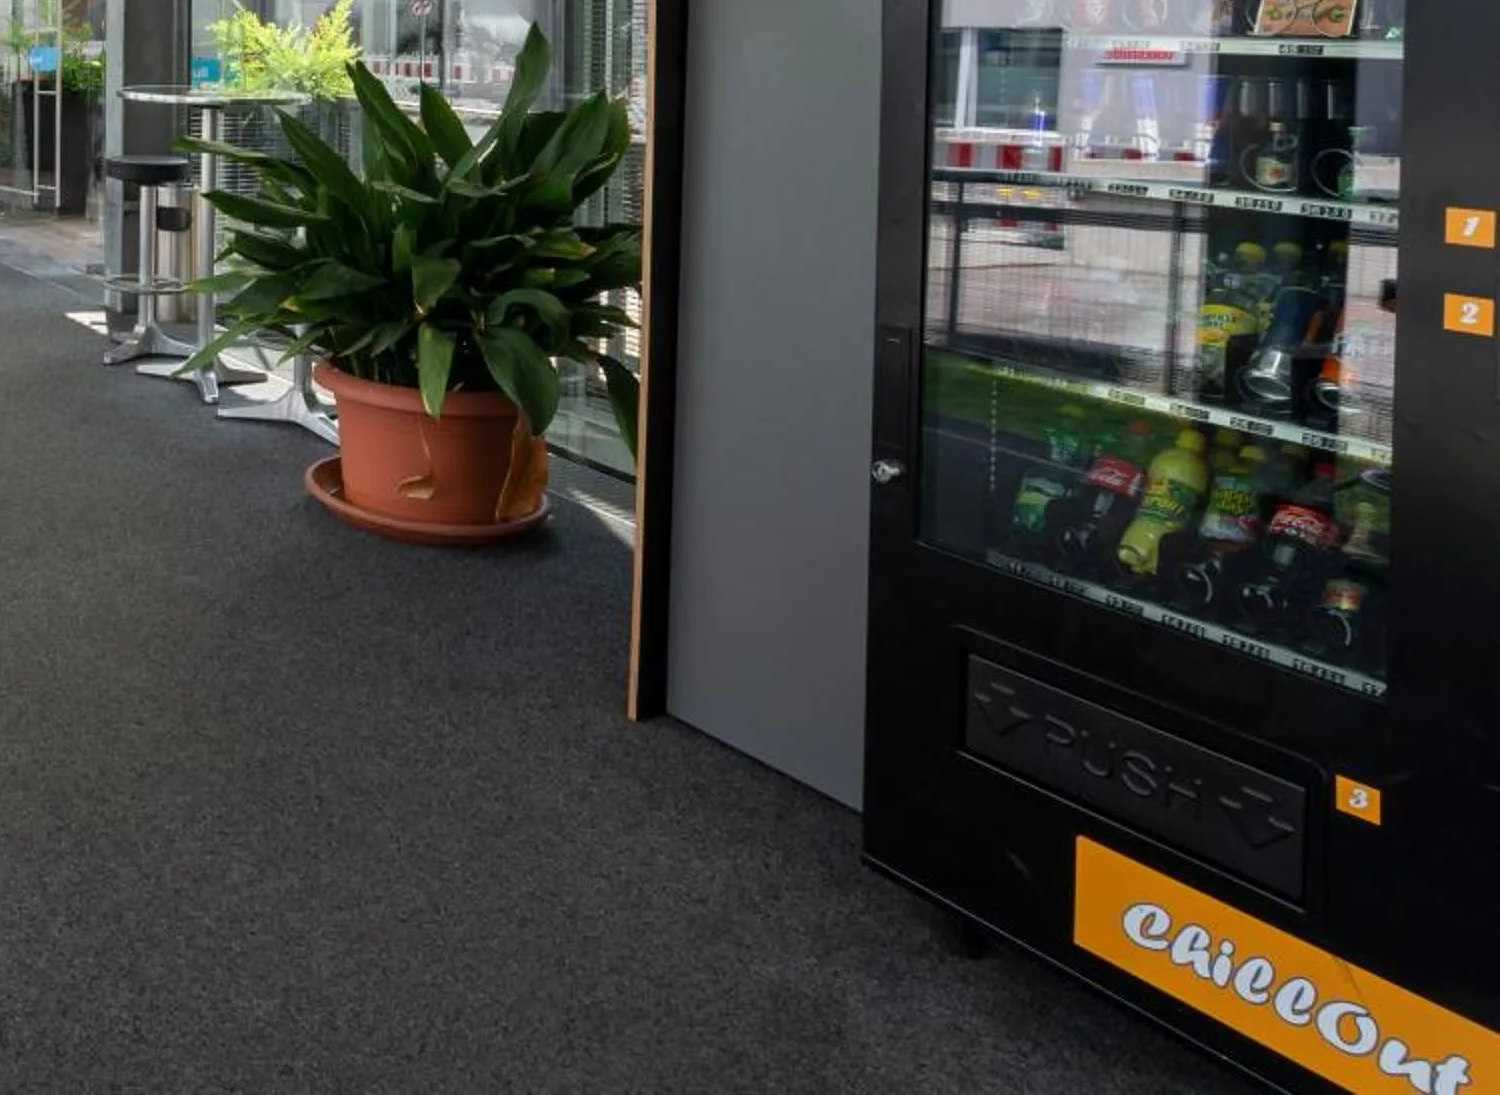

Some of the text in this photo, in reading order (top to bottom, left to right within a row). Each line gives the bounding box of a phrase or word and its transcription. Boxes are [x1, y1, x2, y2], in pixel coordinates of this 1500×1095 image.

[1462, 216, 1481, 237] 1
[1460, 303, 1479, 324] 2
[1045, 714, 1203, 822] PUSH
[1348, 788, 1369, 809] 3
